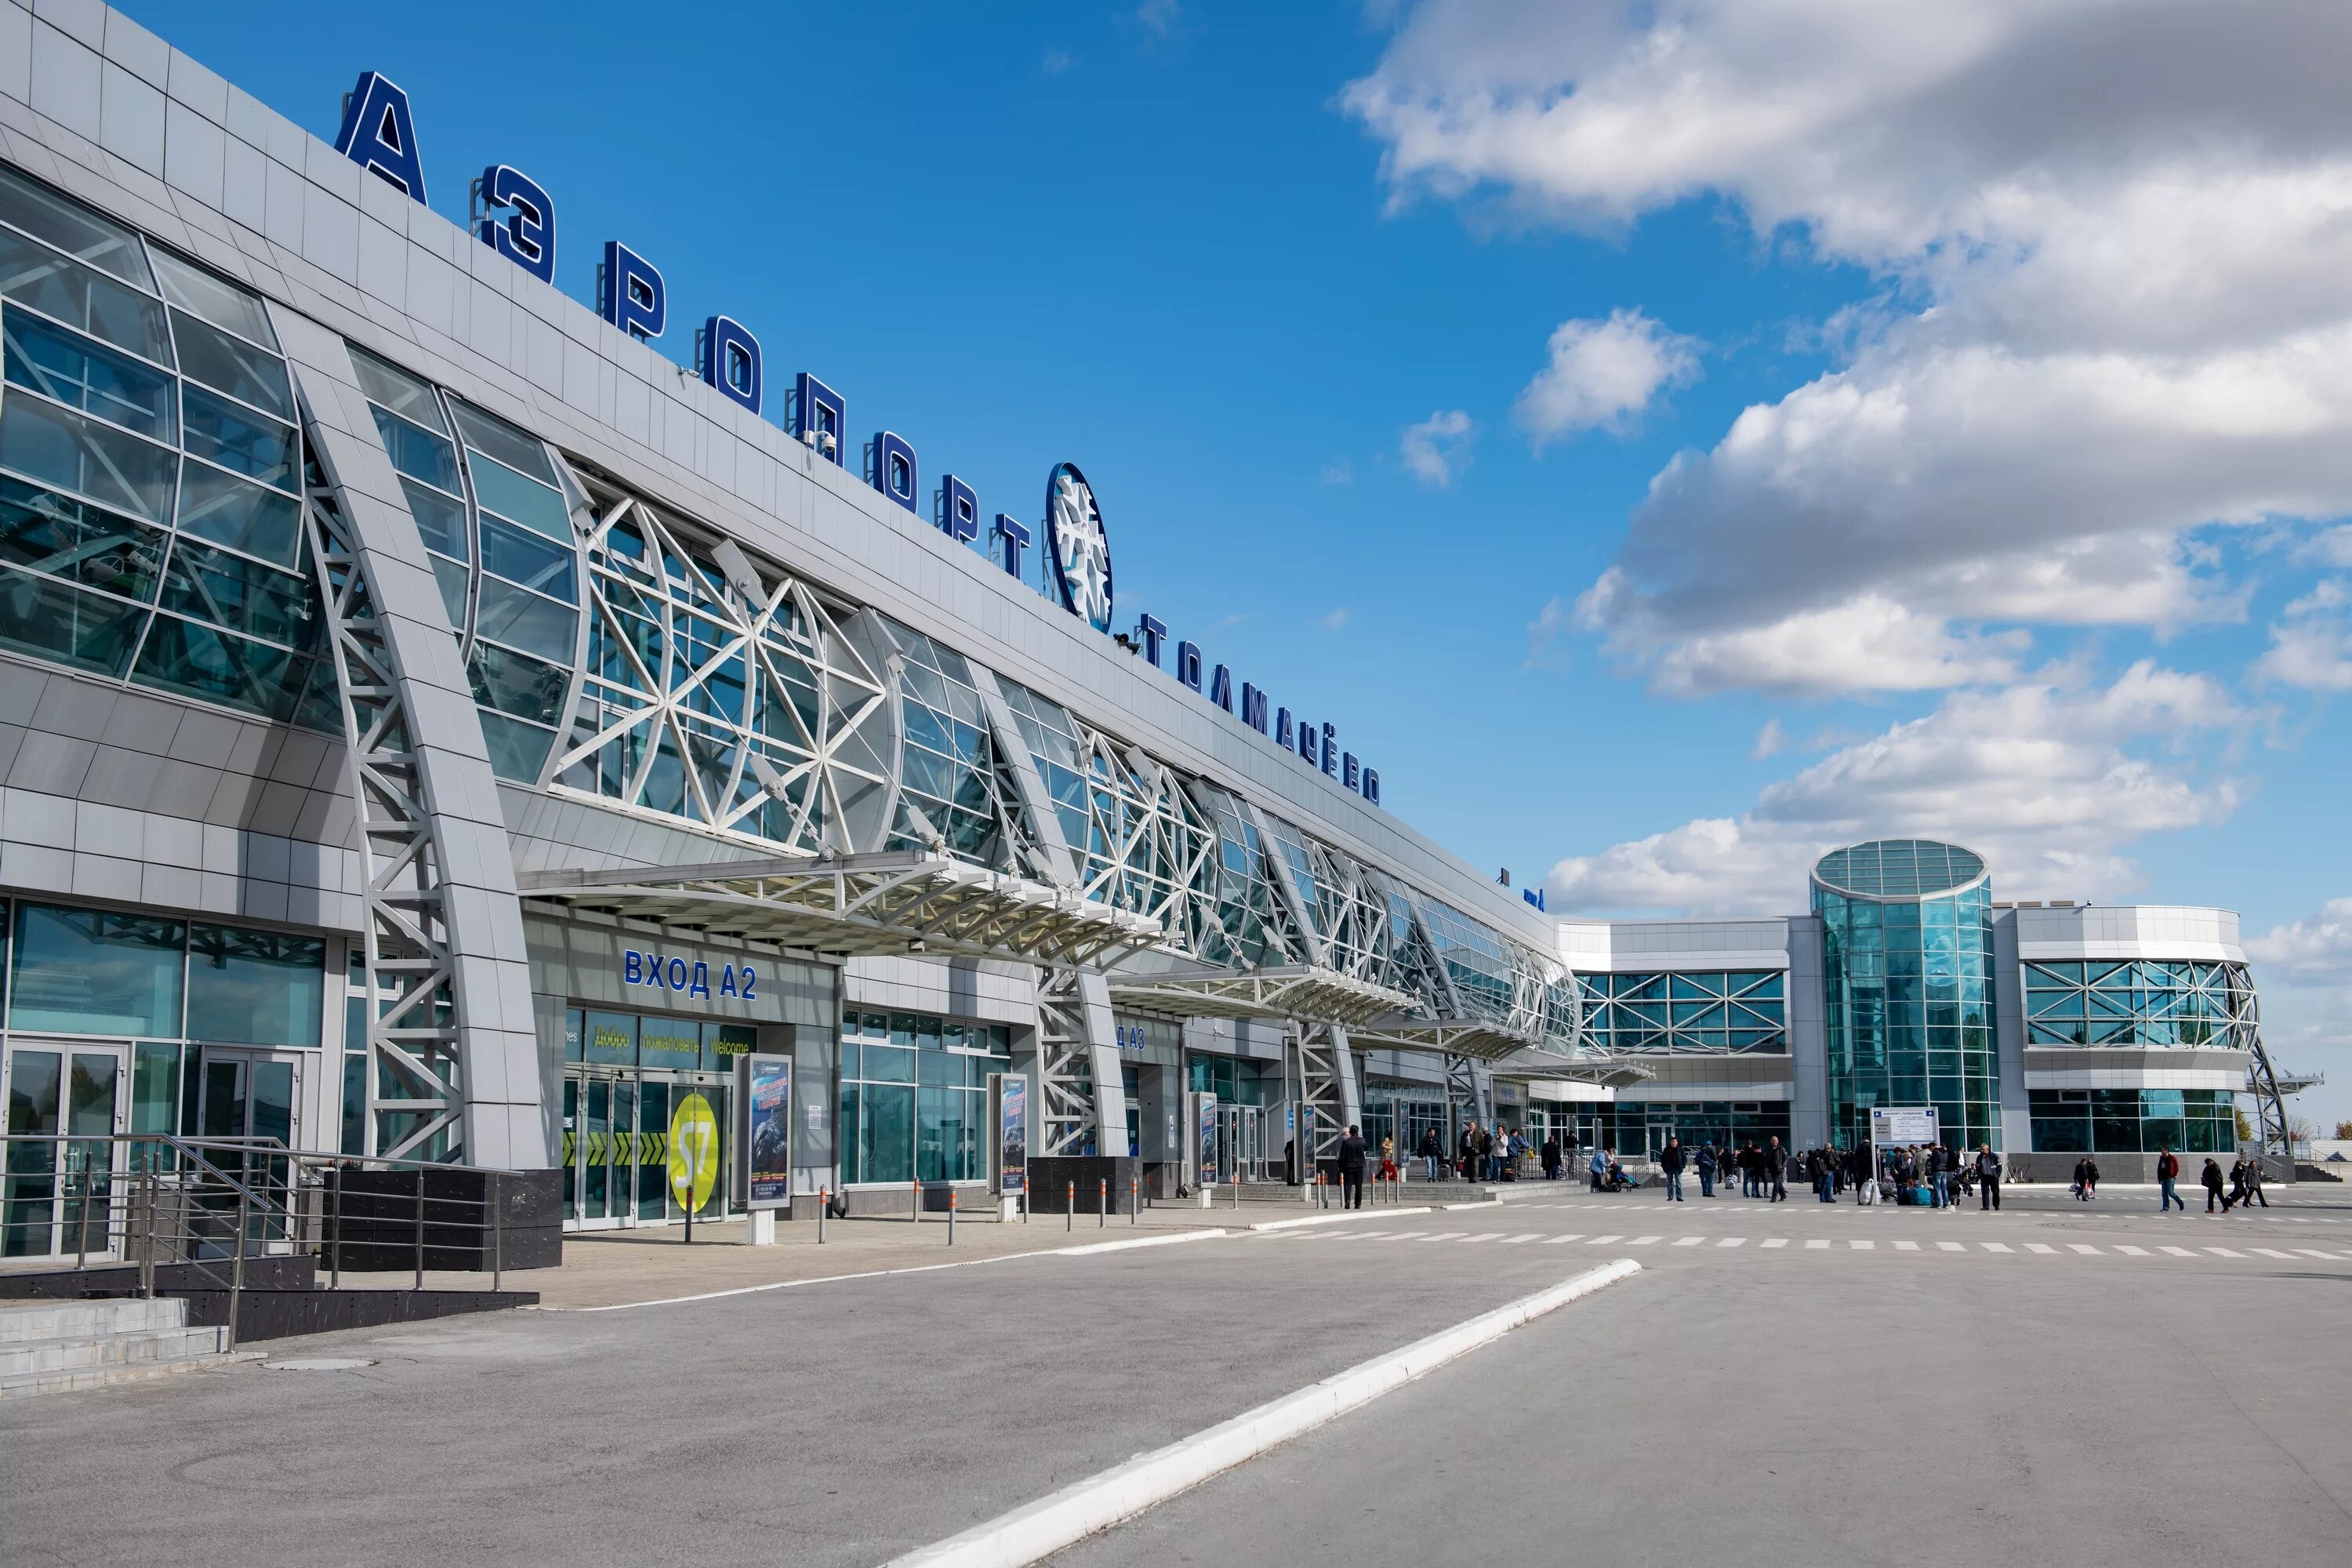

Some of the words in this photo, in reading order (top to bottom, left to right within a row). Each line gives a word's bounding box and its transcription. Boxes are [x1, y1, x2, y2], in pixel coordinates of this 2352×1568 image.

[335, 71, 1030, 580] АЭРОПОРТ
[1141, 613, 1380, 808] ТОЛМАЧЁВО
[625, 949, 710, 1001] ВХОД
[719, 963, 757, 1001] А2
[594, 1025, 630, 1050] Добро
[643, 1035, 699, 1053] пожаловать
[710, 1036, 749, 1055] Welcome
[675, 1121, 712, 1188] S7
